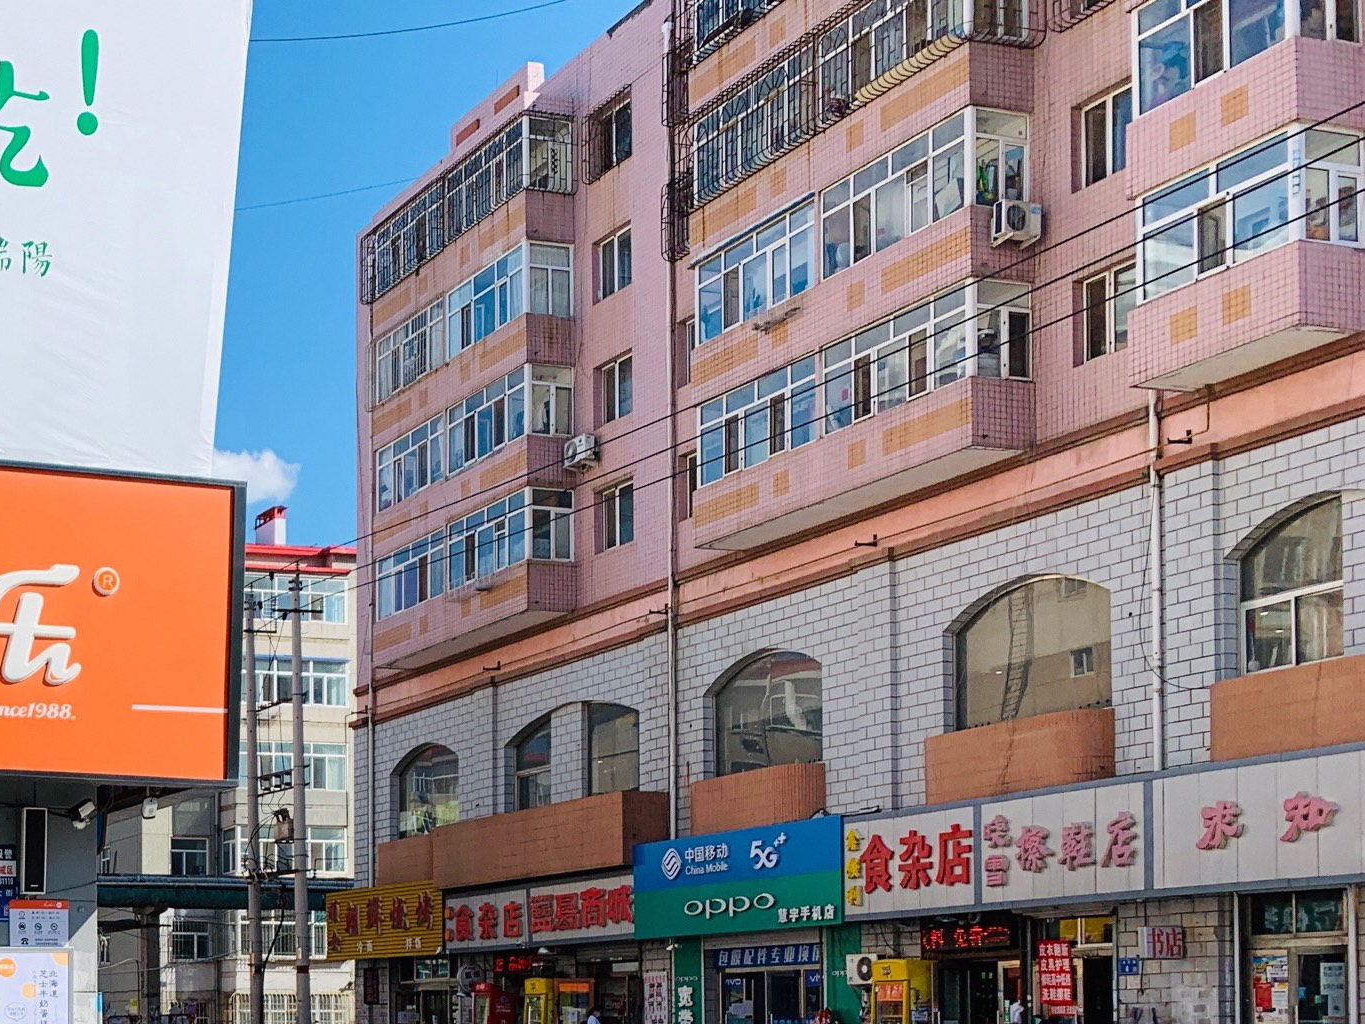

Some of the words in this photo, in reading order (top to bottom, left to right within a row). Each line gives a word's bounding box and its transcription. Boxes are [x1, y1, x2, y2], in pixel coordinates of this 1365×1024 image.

[685, 843, 728, 863] 中国移动
[859, 823, 973, 894] 食杂店
[455, 902, 522, 942] 食杂店
[1147, 927, 1182, 958] 书店
